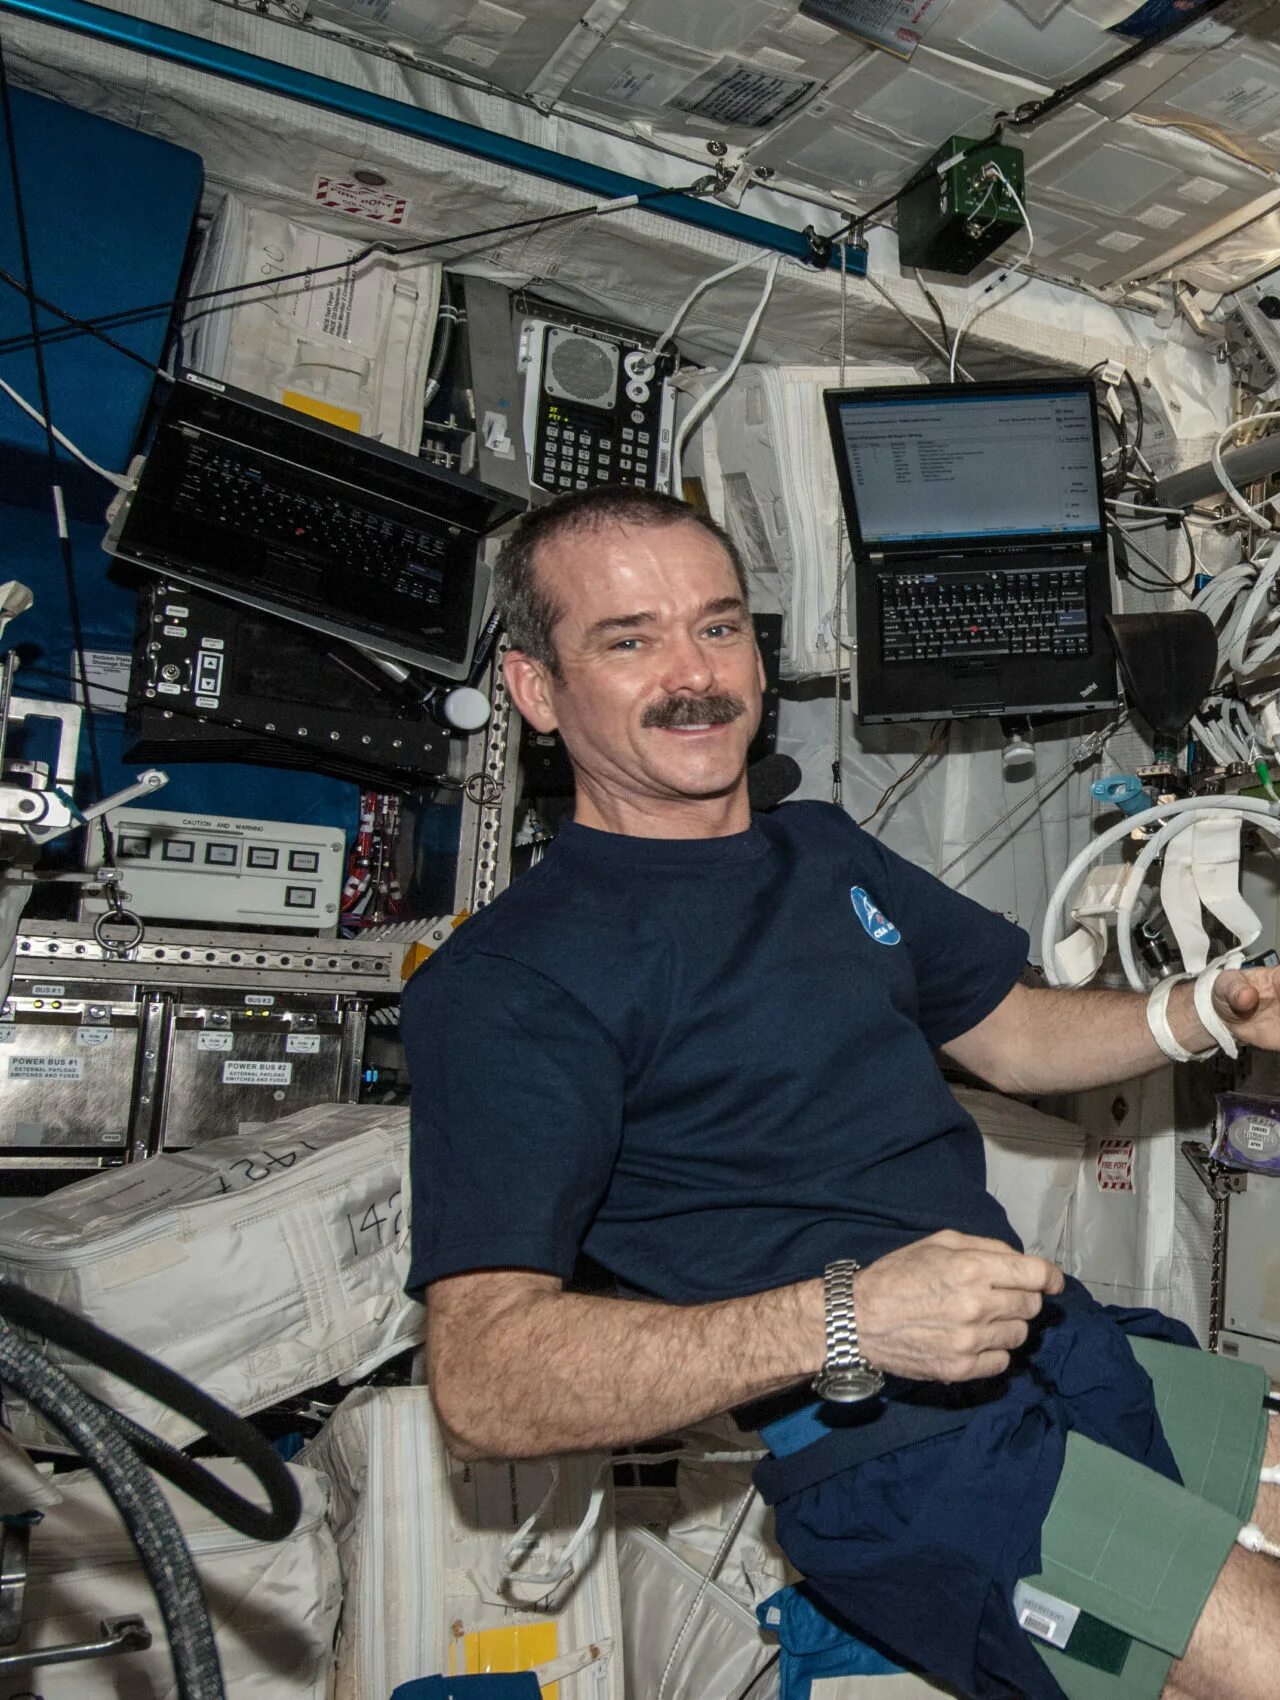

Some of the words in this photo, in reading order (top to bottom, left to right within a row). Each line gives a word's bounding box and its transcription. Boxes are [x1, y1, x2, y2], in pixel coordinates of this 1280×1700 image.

[182, 818, 212, 829] CAUTION
[216, 822, 230, 830] AND
[236, 823, 264, 833] WARNING
[12, 1058, 44, 1066] POWER
[47, 1058, 66, 1066] BUS
[259, 1063, 276, 1071] BUS
